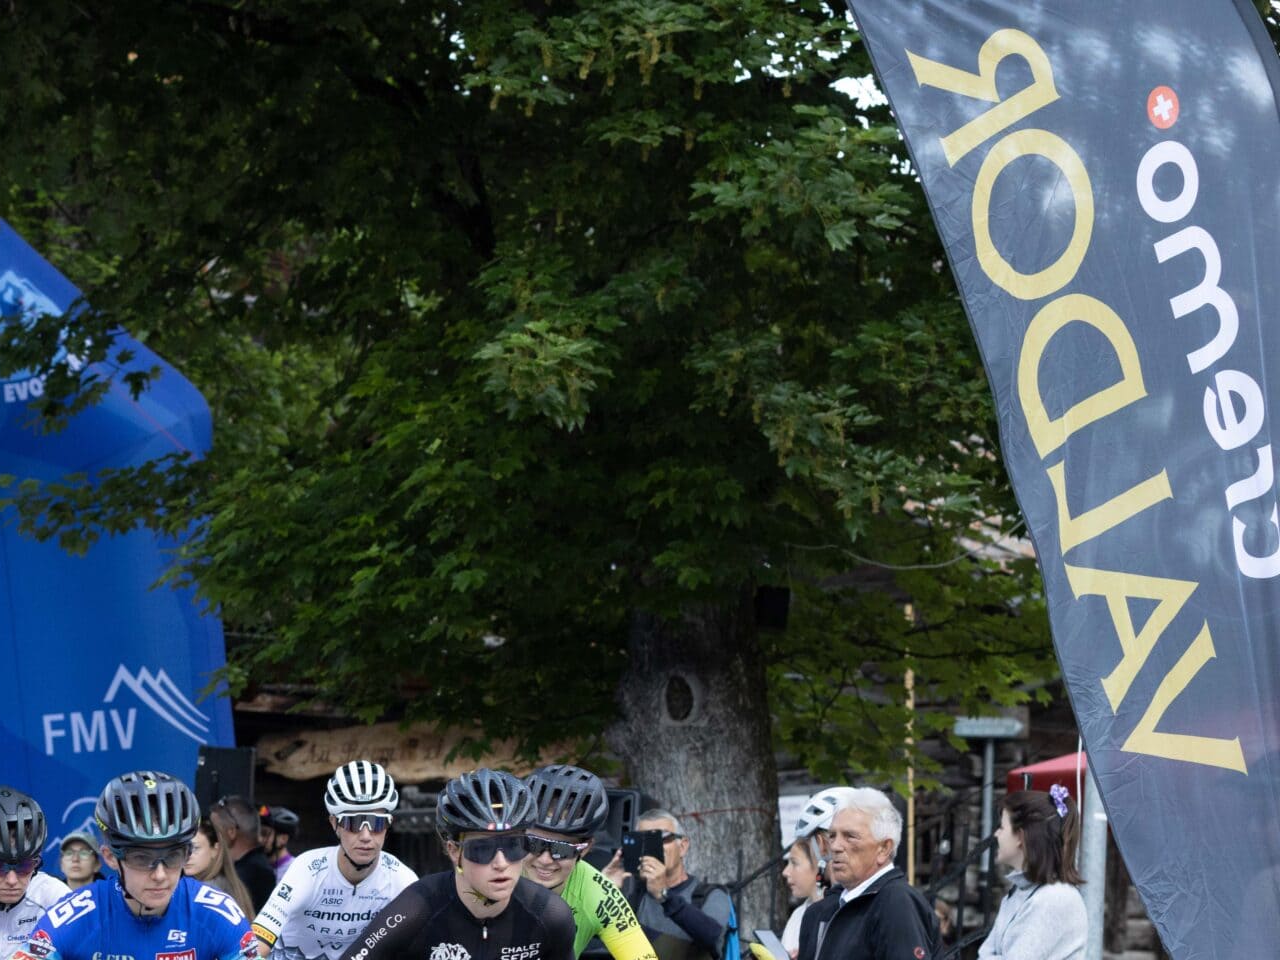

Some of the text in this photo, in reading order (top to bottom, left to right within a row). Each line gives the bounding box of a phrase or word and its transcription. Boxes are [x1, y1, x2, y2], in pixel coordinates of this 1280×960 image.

[44, 709, 138, 756] FMV
[46, 889, 97, 929] GS
[604, 896, 629, 933] nova
[167, 929, 187, 944] GS
[365, 928, 387, 950] Bike
[386, 912, 407, 929] Co.
[501, 942, 542, 954] CHALET
